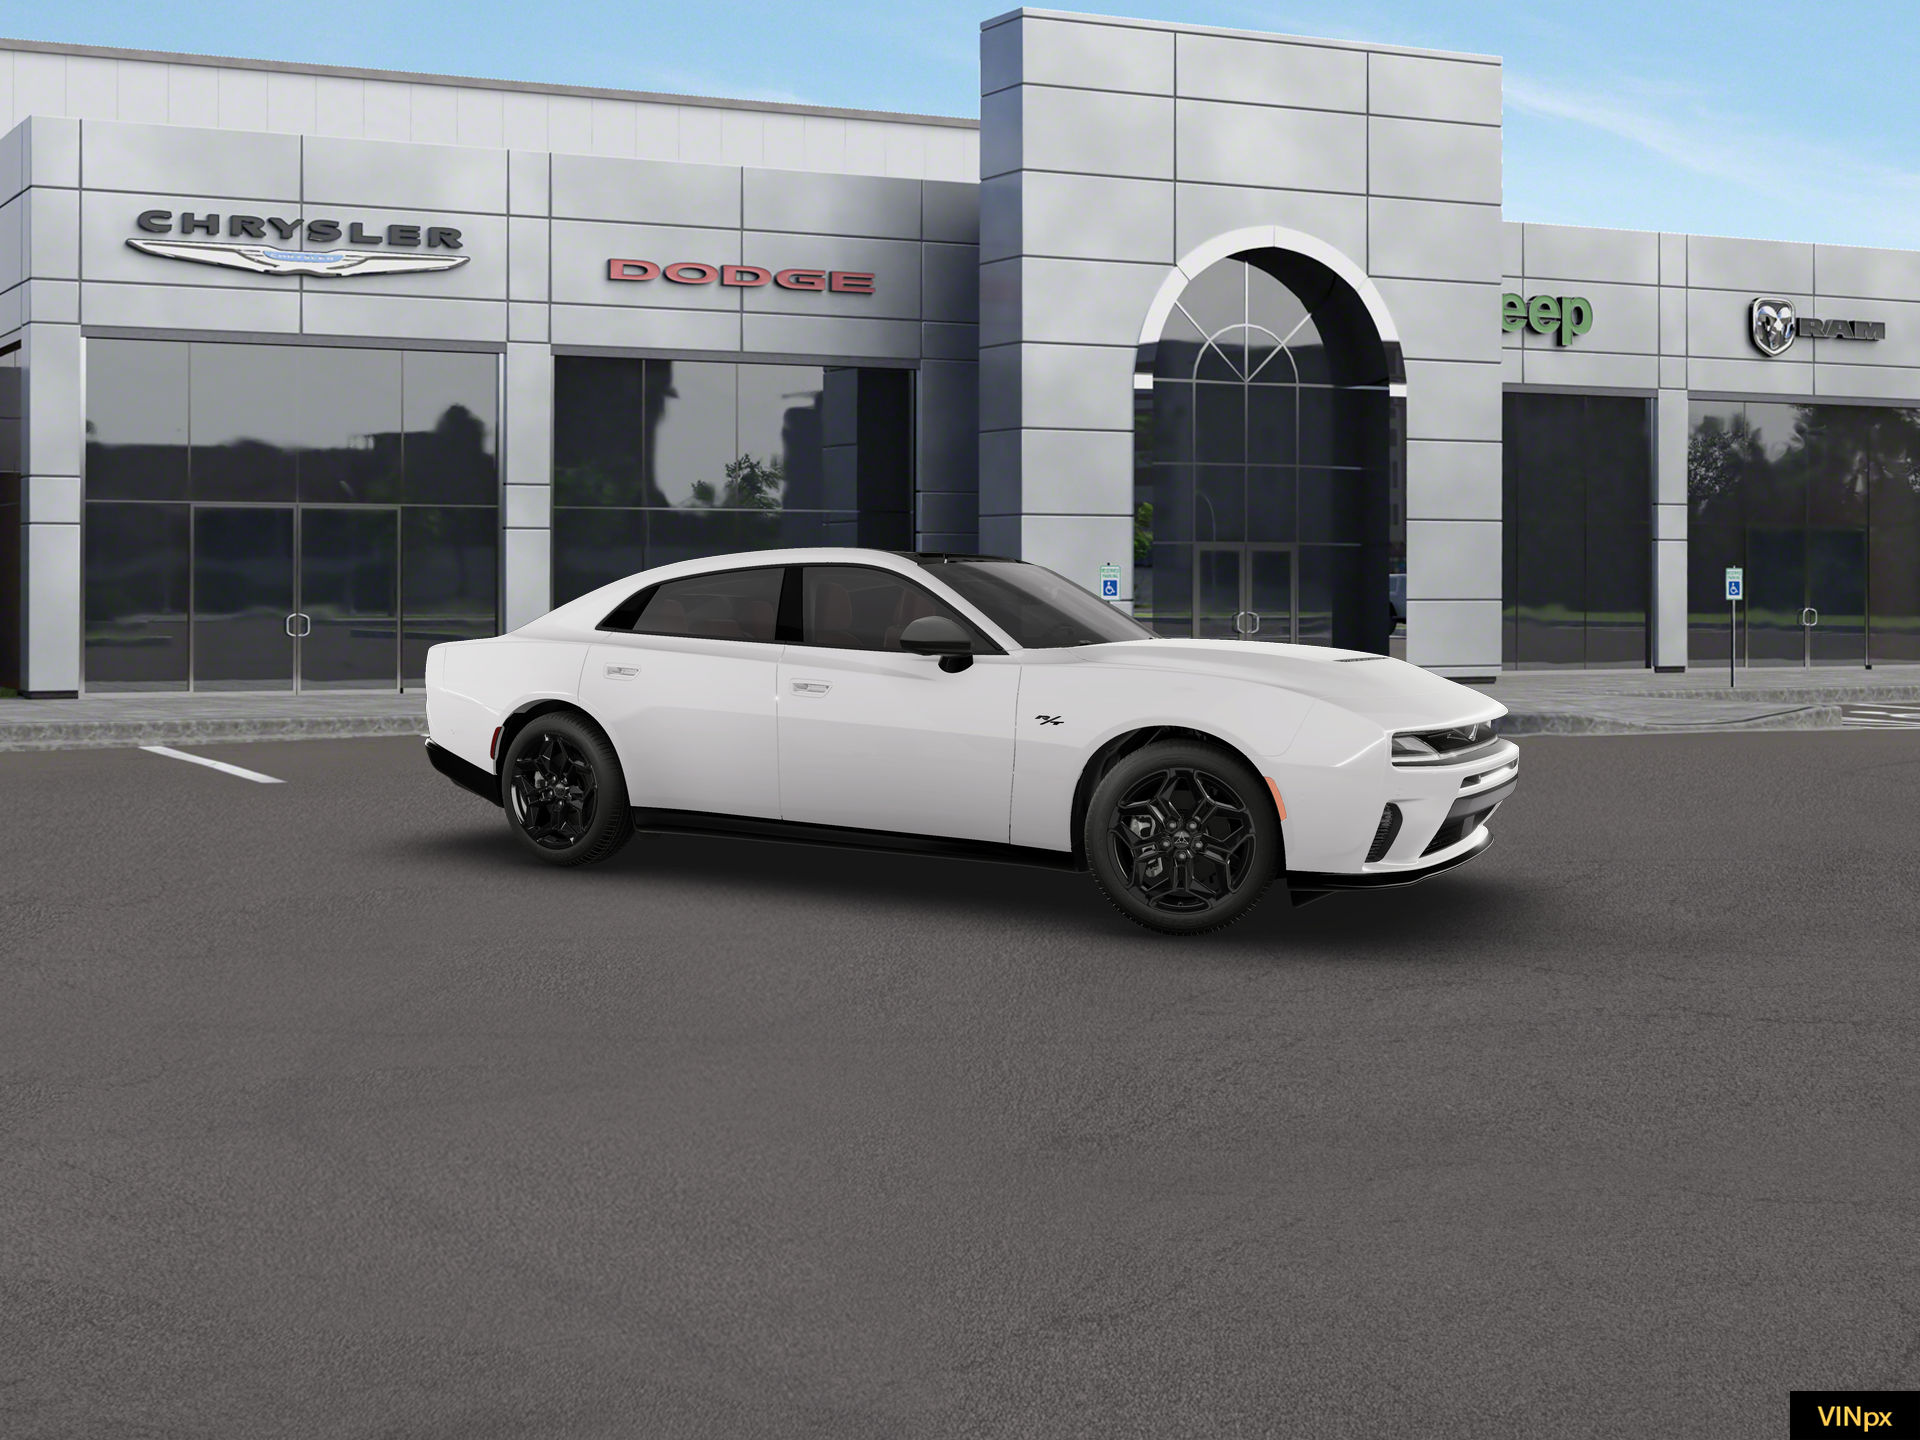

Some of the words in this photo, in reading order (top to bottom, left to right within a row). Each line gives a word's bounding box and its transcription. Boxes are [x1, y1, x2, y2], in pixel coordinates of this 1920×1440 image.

[137, 209, 463, 249] CHRYSLER
[270, 253, 334, 261] CHRYSLER
[607, 258, 876, 294] DODGE
[1502, 293, 1593, 347] eep
[1796, 317, 1886, 341] RAM
[1034, 715, 1064, 725] R/T
